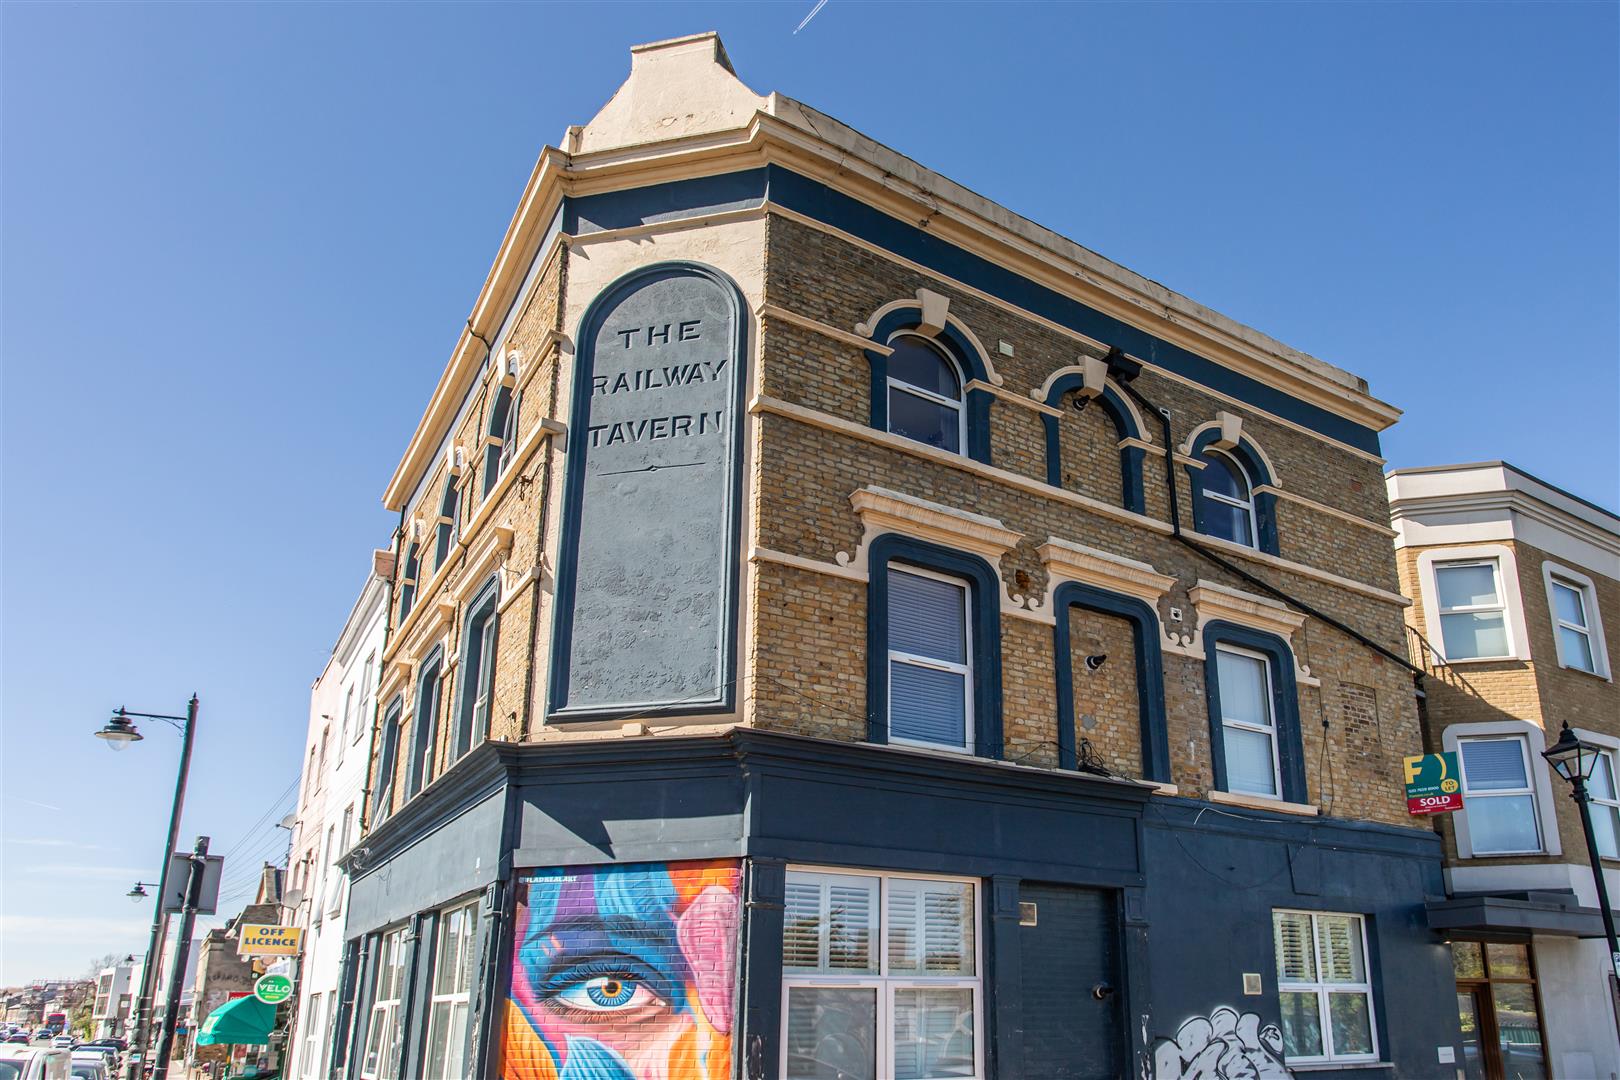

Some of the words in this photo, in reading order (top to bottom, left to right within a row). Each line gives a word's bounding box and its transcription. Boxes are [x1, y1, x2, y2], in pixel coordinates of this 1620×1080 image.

[617, 320, 702, 349] THE
[592, 359, 728, 397] RAILWAY
[588, 411, 723, 448] TAVERN
[1420, 796, 1450, 806] SOLD
[259, 928, 286, 936] OFF
[244, 937, 297, 947] LICENCE
[259, 983, 291, 993] VELO
